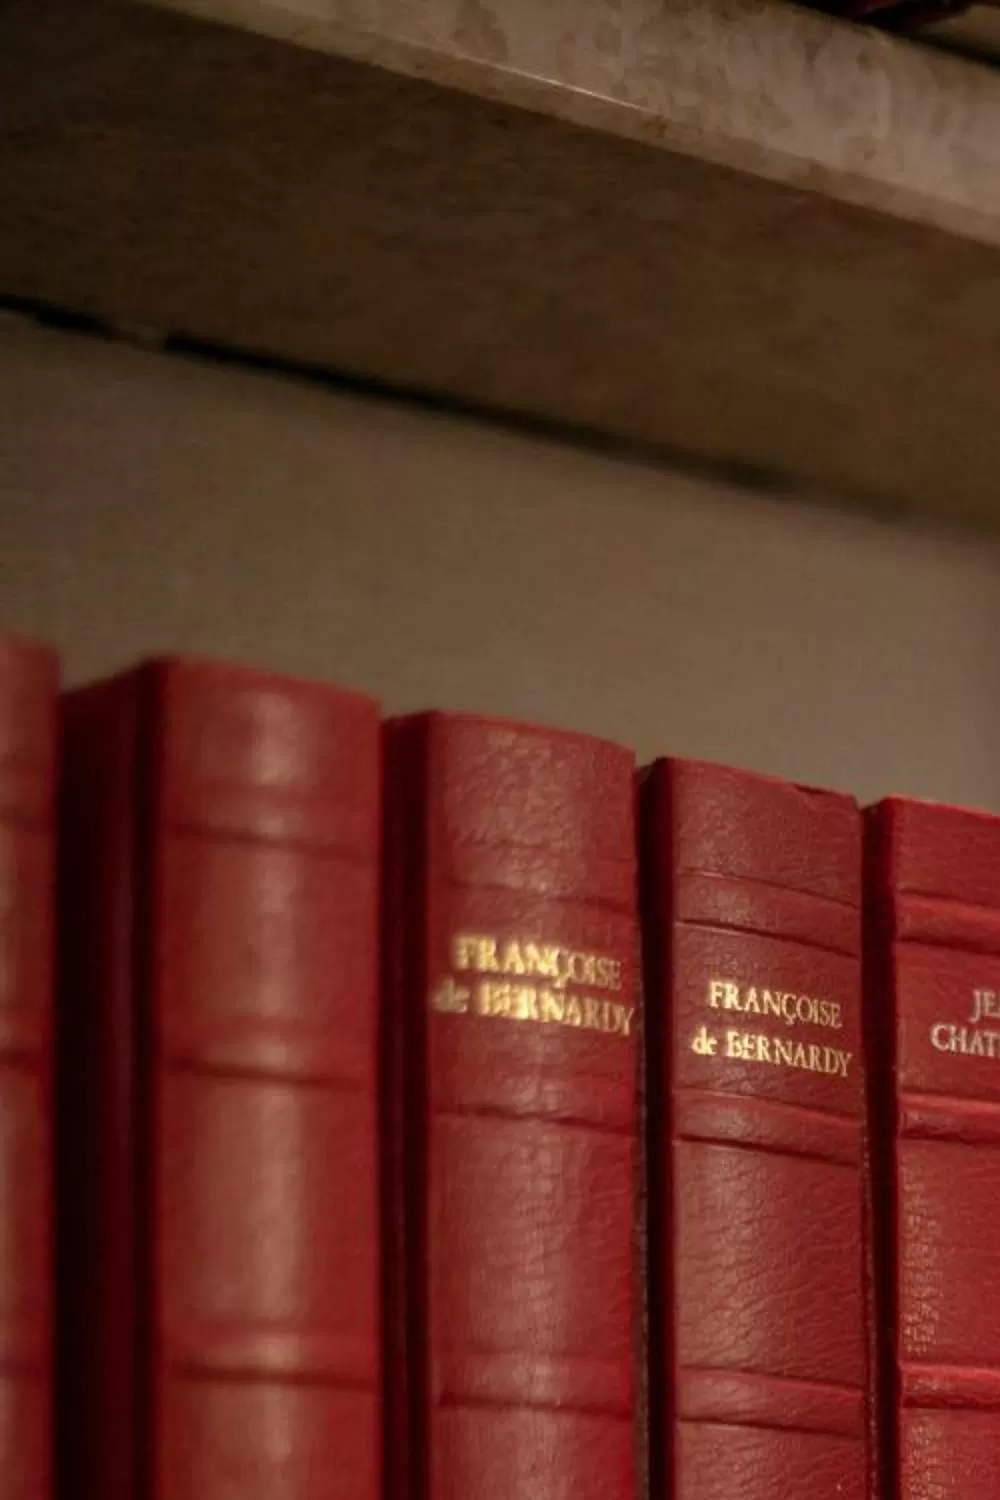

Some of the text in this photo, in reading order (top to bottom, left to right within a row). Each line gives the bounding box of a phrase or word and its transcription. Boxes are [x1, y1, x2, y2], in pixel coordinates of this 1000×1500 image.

[479, 982, 635, 1037] BERNARDY
[708, 979, 843, 1029] FRANÇOISE
[692, 1026, 853, 1078] de BERNARDY
